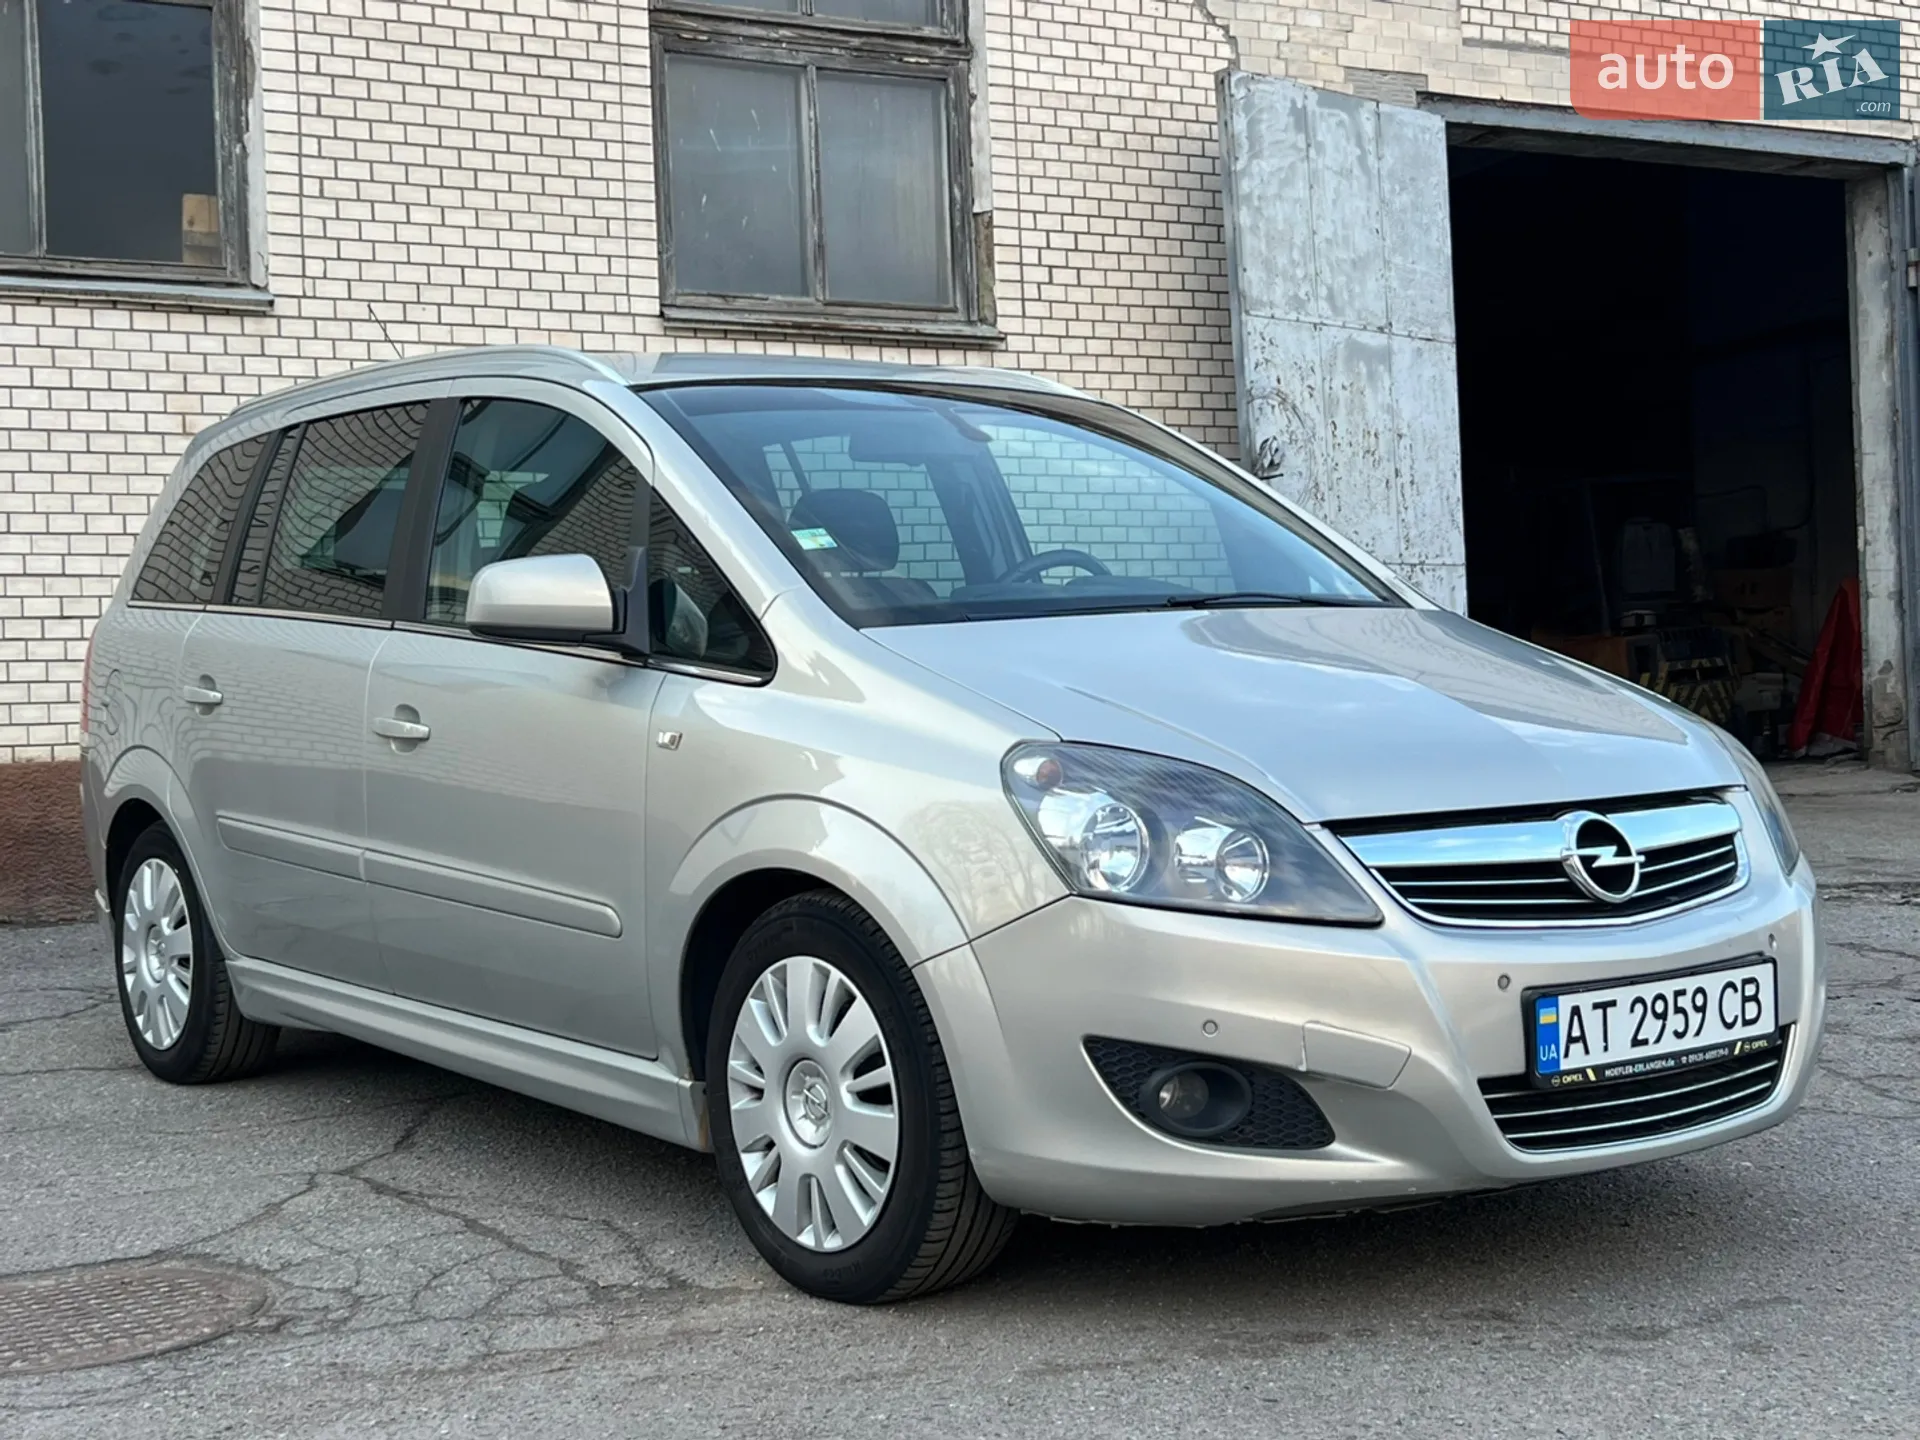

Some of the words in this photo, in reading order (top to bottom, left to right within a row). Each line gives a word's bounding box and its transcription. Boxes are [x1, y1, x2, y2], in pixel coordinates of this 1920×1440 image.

[1563, 999, 1617, 1059] AT
[1629, 986, 1708, 1049] 2959
[1718, 976, 1763, 1030] CB
[1540, 1045, 1558, 1062] UA
[1562, 1073, 1584, 1084] OPEL
[1751, 1039, 1769, 1050] OPEL
